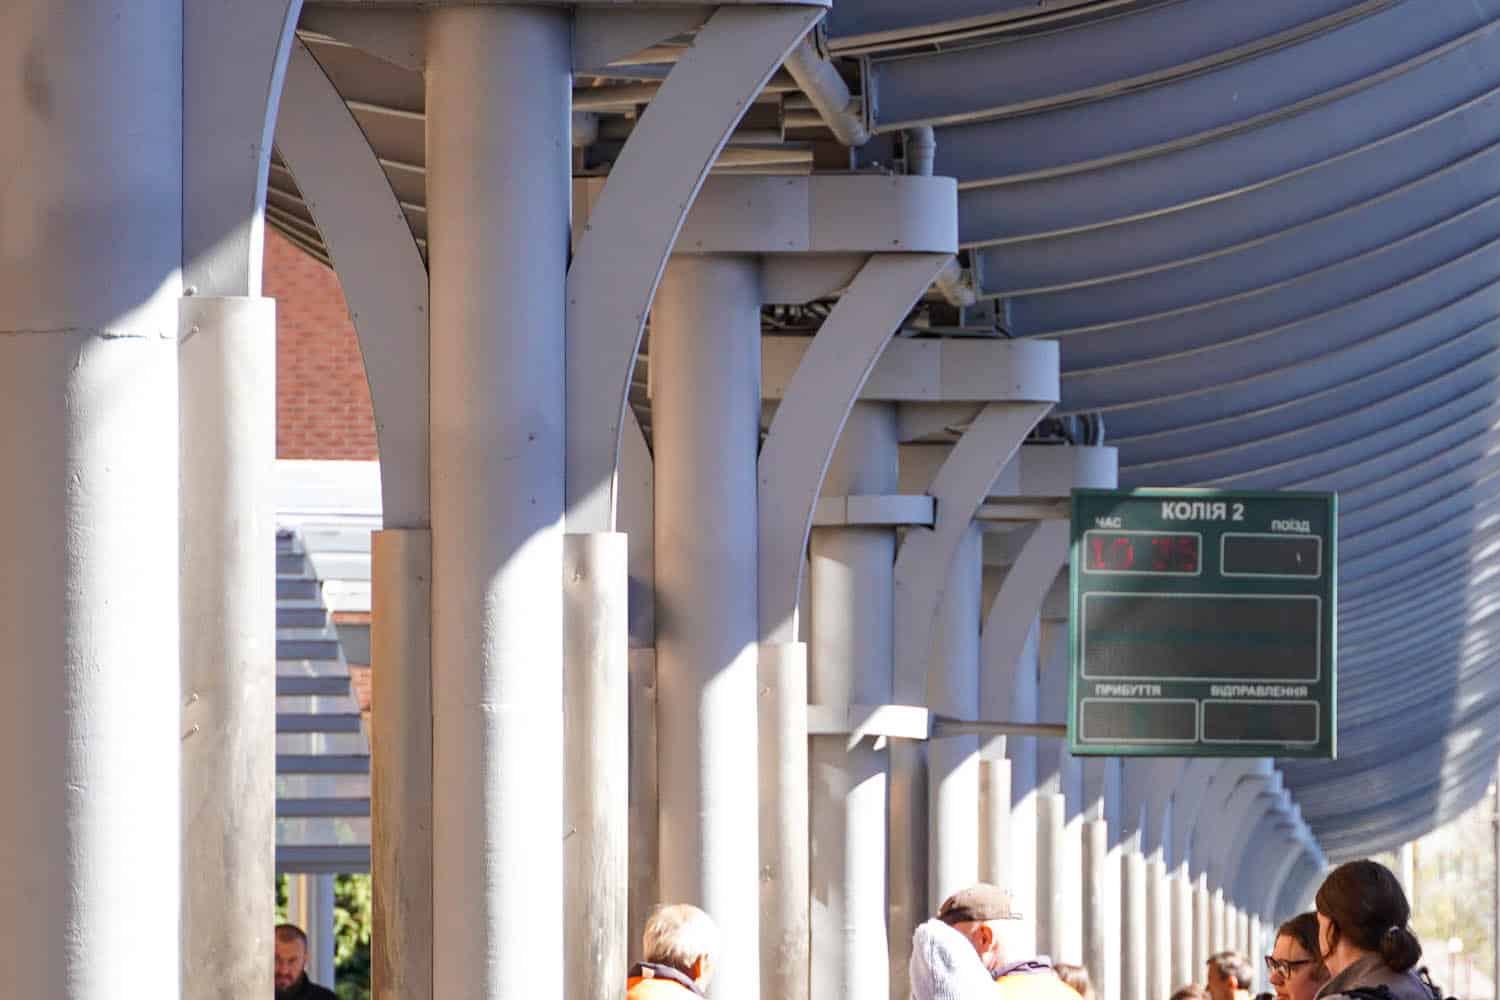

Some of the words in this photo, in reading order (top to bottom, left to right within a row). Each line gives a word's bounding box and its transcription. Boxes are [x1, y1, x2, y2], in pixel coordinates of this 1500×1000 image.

[1162, 502, 1226, 521] КОЛІЯ
[1232, 503, 1245, 521] 2
[1095, 516, 1122, 529] ЧАС
[1095, 683, 1161, 697] ПРИБУТТЯ
[1210, 684, 1308, 697] ВІДПРАВЛЕННЯ
